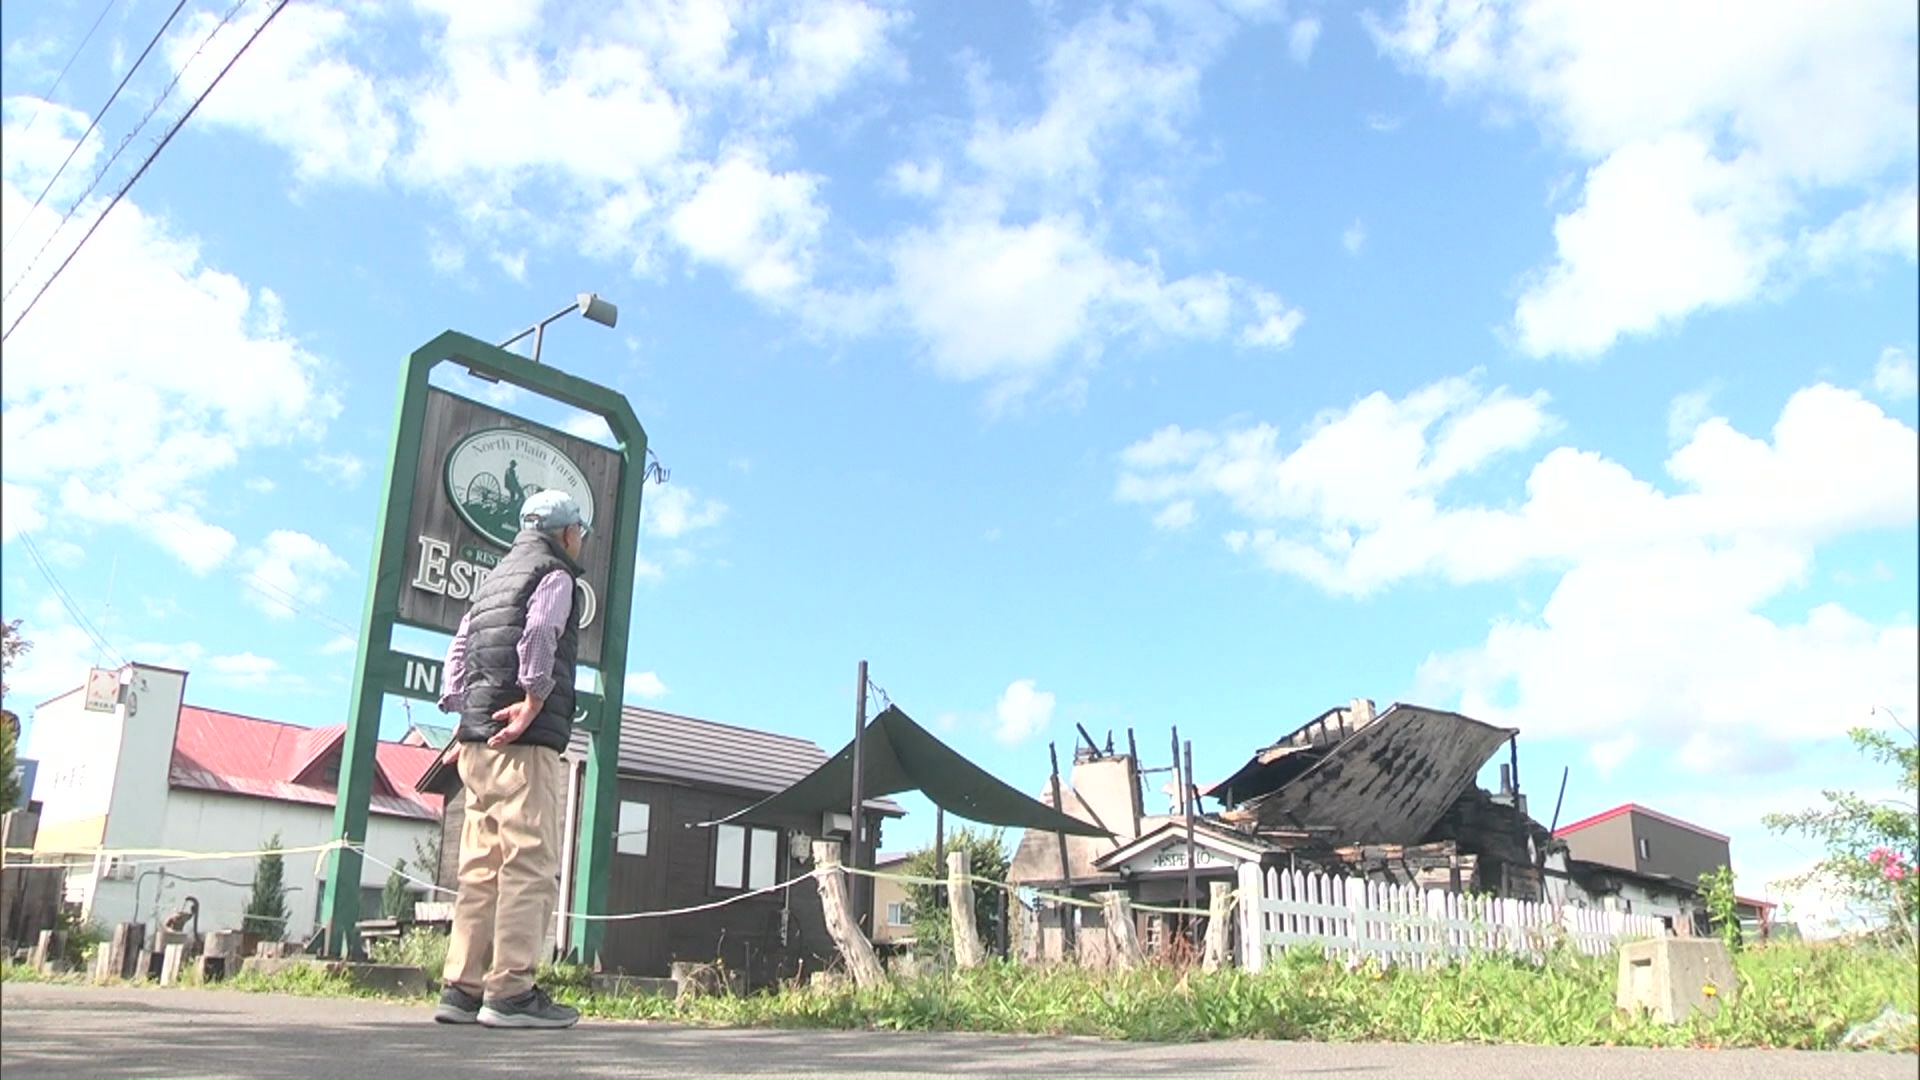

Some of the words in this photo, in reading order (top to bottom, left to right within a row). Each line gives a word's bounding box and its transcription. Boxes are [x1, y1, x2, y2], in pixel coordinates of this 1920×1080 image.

[472, 437, 510, 456] North
[515, 438, 548, 461] Plain
[550, 455, 578, 488] Farm
[403, 660, 437, 693] IN
[1158, 851, 1211, 867] ESPEIO
